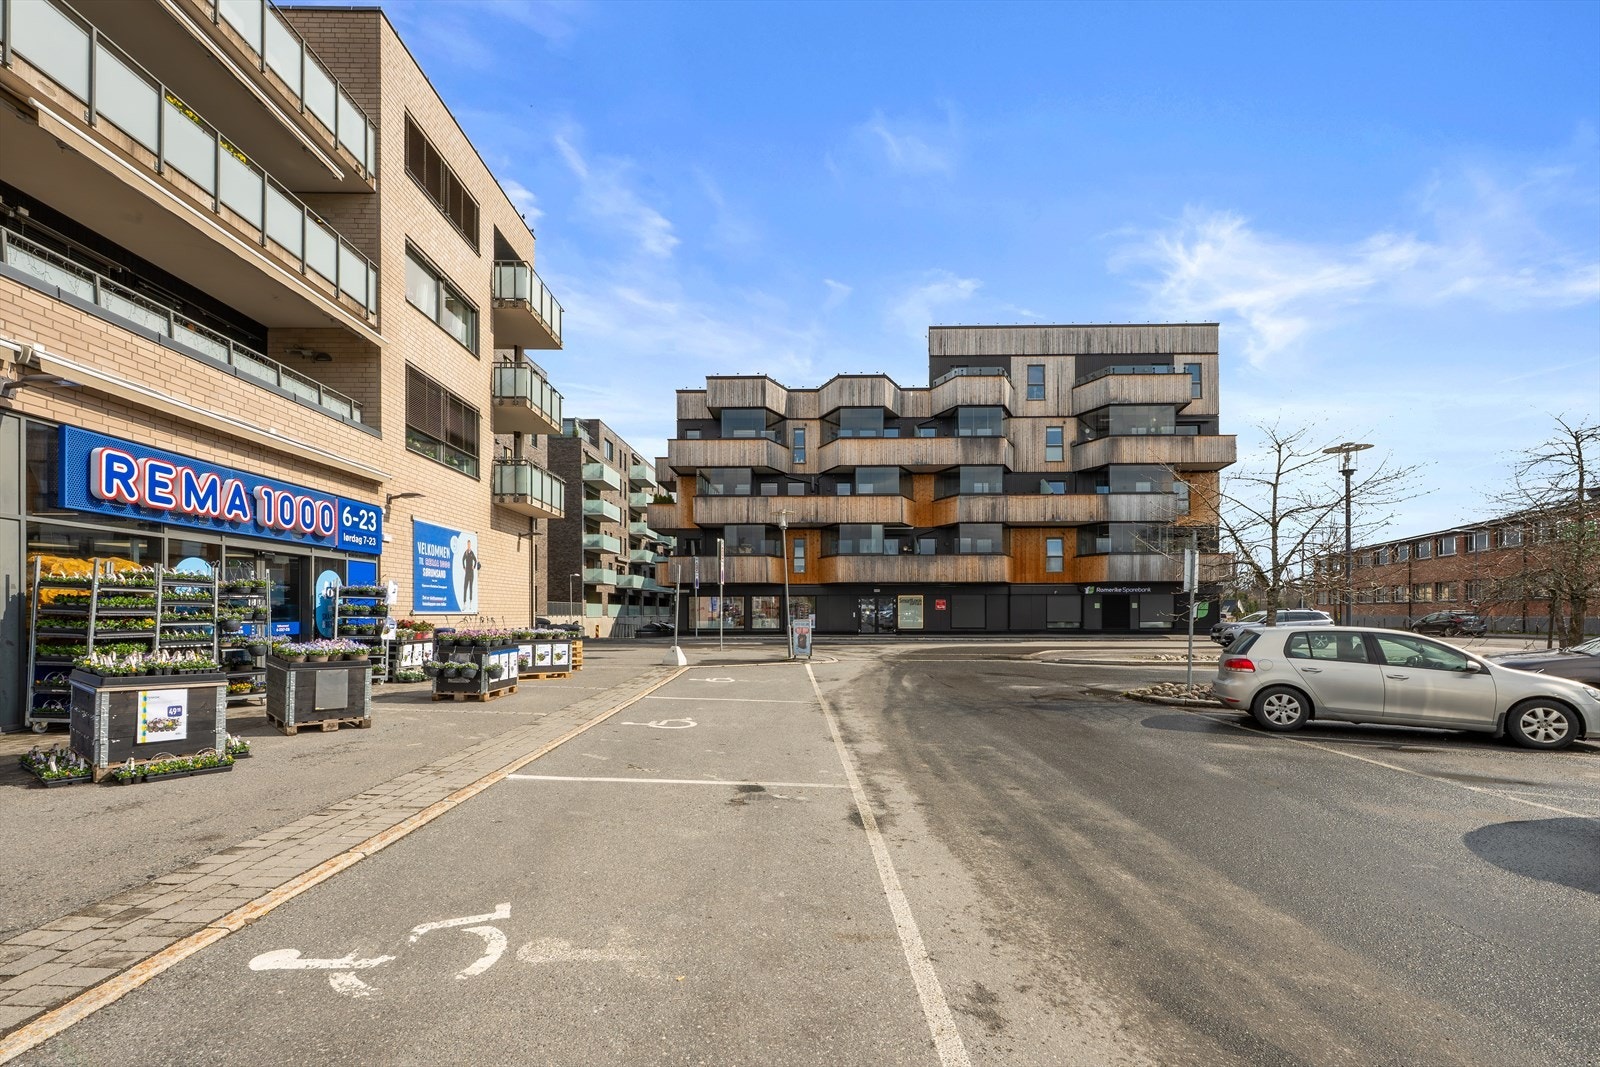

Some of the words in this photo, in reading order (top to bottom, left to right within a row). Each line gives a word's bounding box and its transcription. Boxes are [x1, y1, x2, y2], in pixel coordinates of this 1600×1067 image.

[95, 447, 250, 522] REMA
[257, 485, 335, 536] 1000
[342, 506, 377, 532] 6-23
[343, 532, 363, 546] lørdag
[363, 535, 377, 546] 7-23
[417, 541, 451, 559] VELKOMMEN
[1122, 586, 1152, 594] Sparebank
